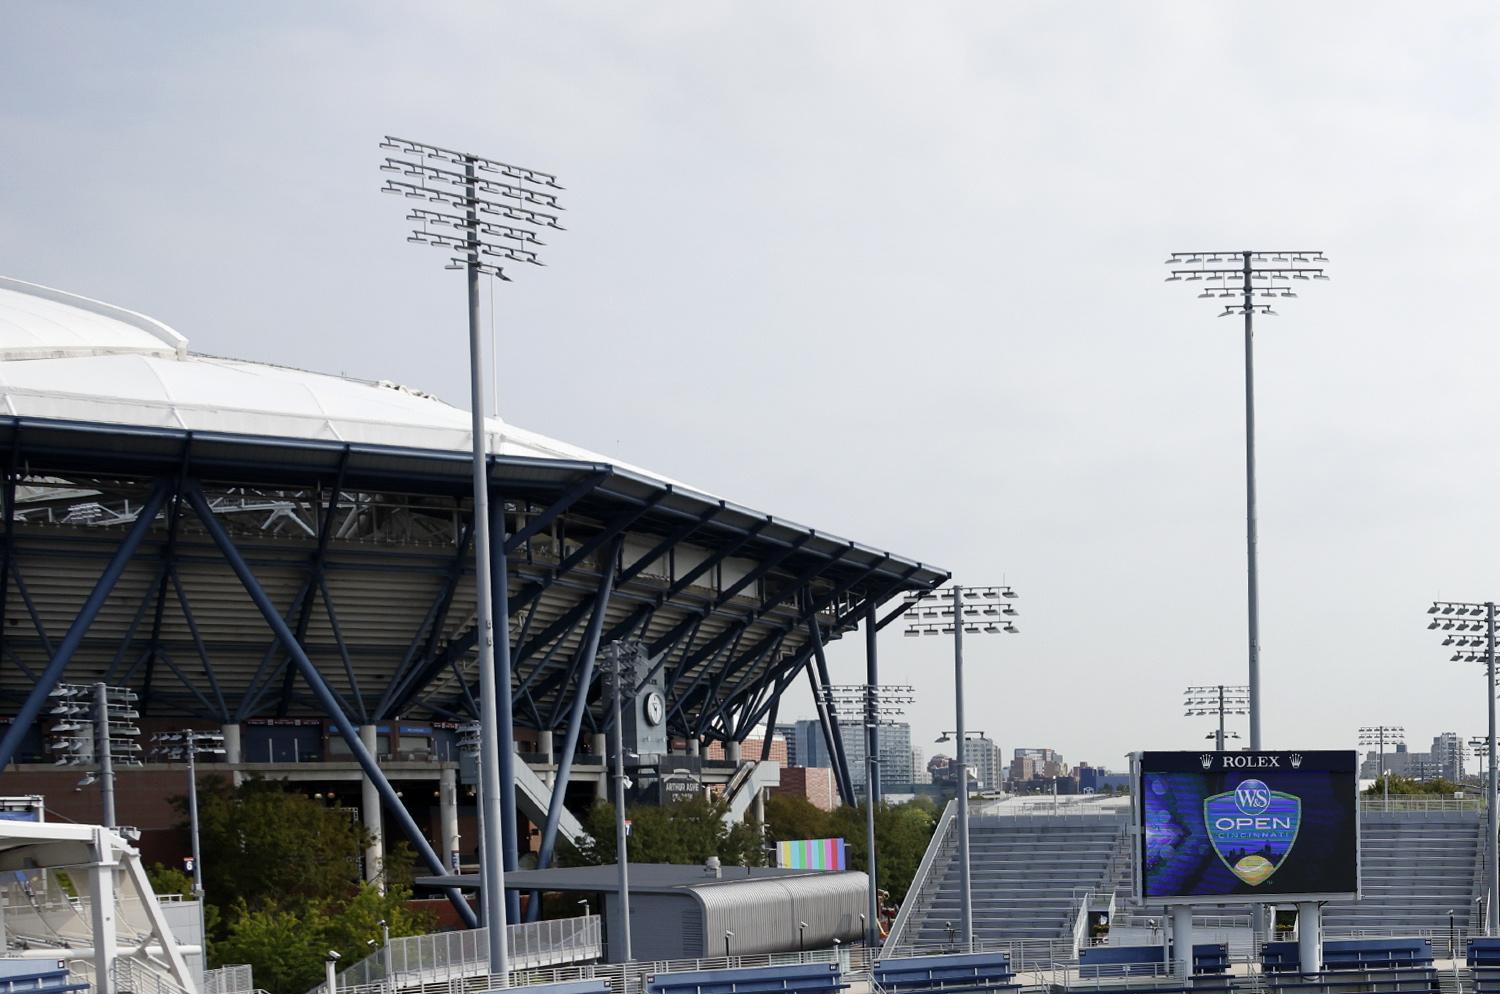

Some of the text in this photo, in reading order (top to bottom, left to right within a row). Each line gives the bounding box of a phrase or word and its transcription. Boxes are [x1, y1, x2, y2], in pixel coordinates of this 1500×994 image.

[1223, 755, 1280, 767] ROLEX
[1237, 790, 1267, 809] W&S
[1215, 817, 1290, 830] OPEN
